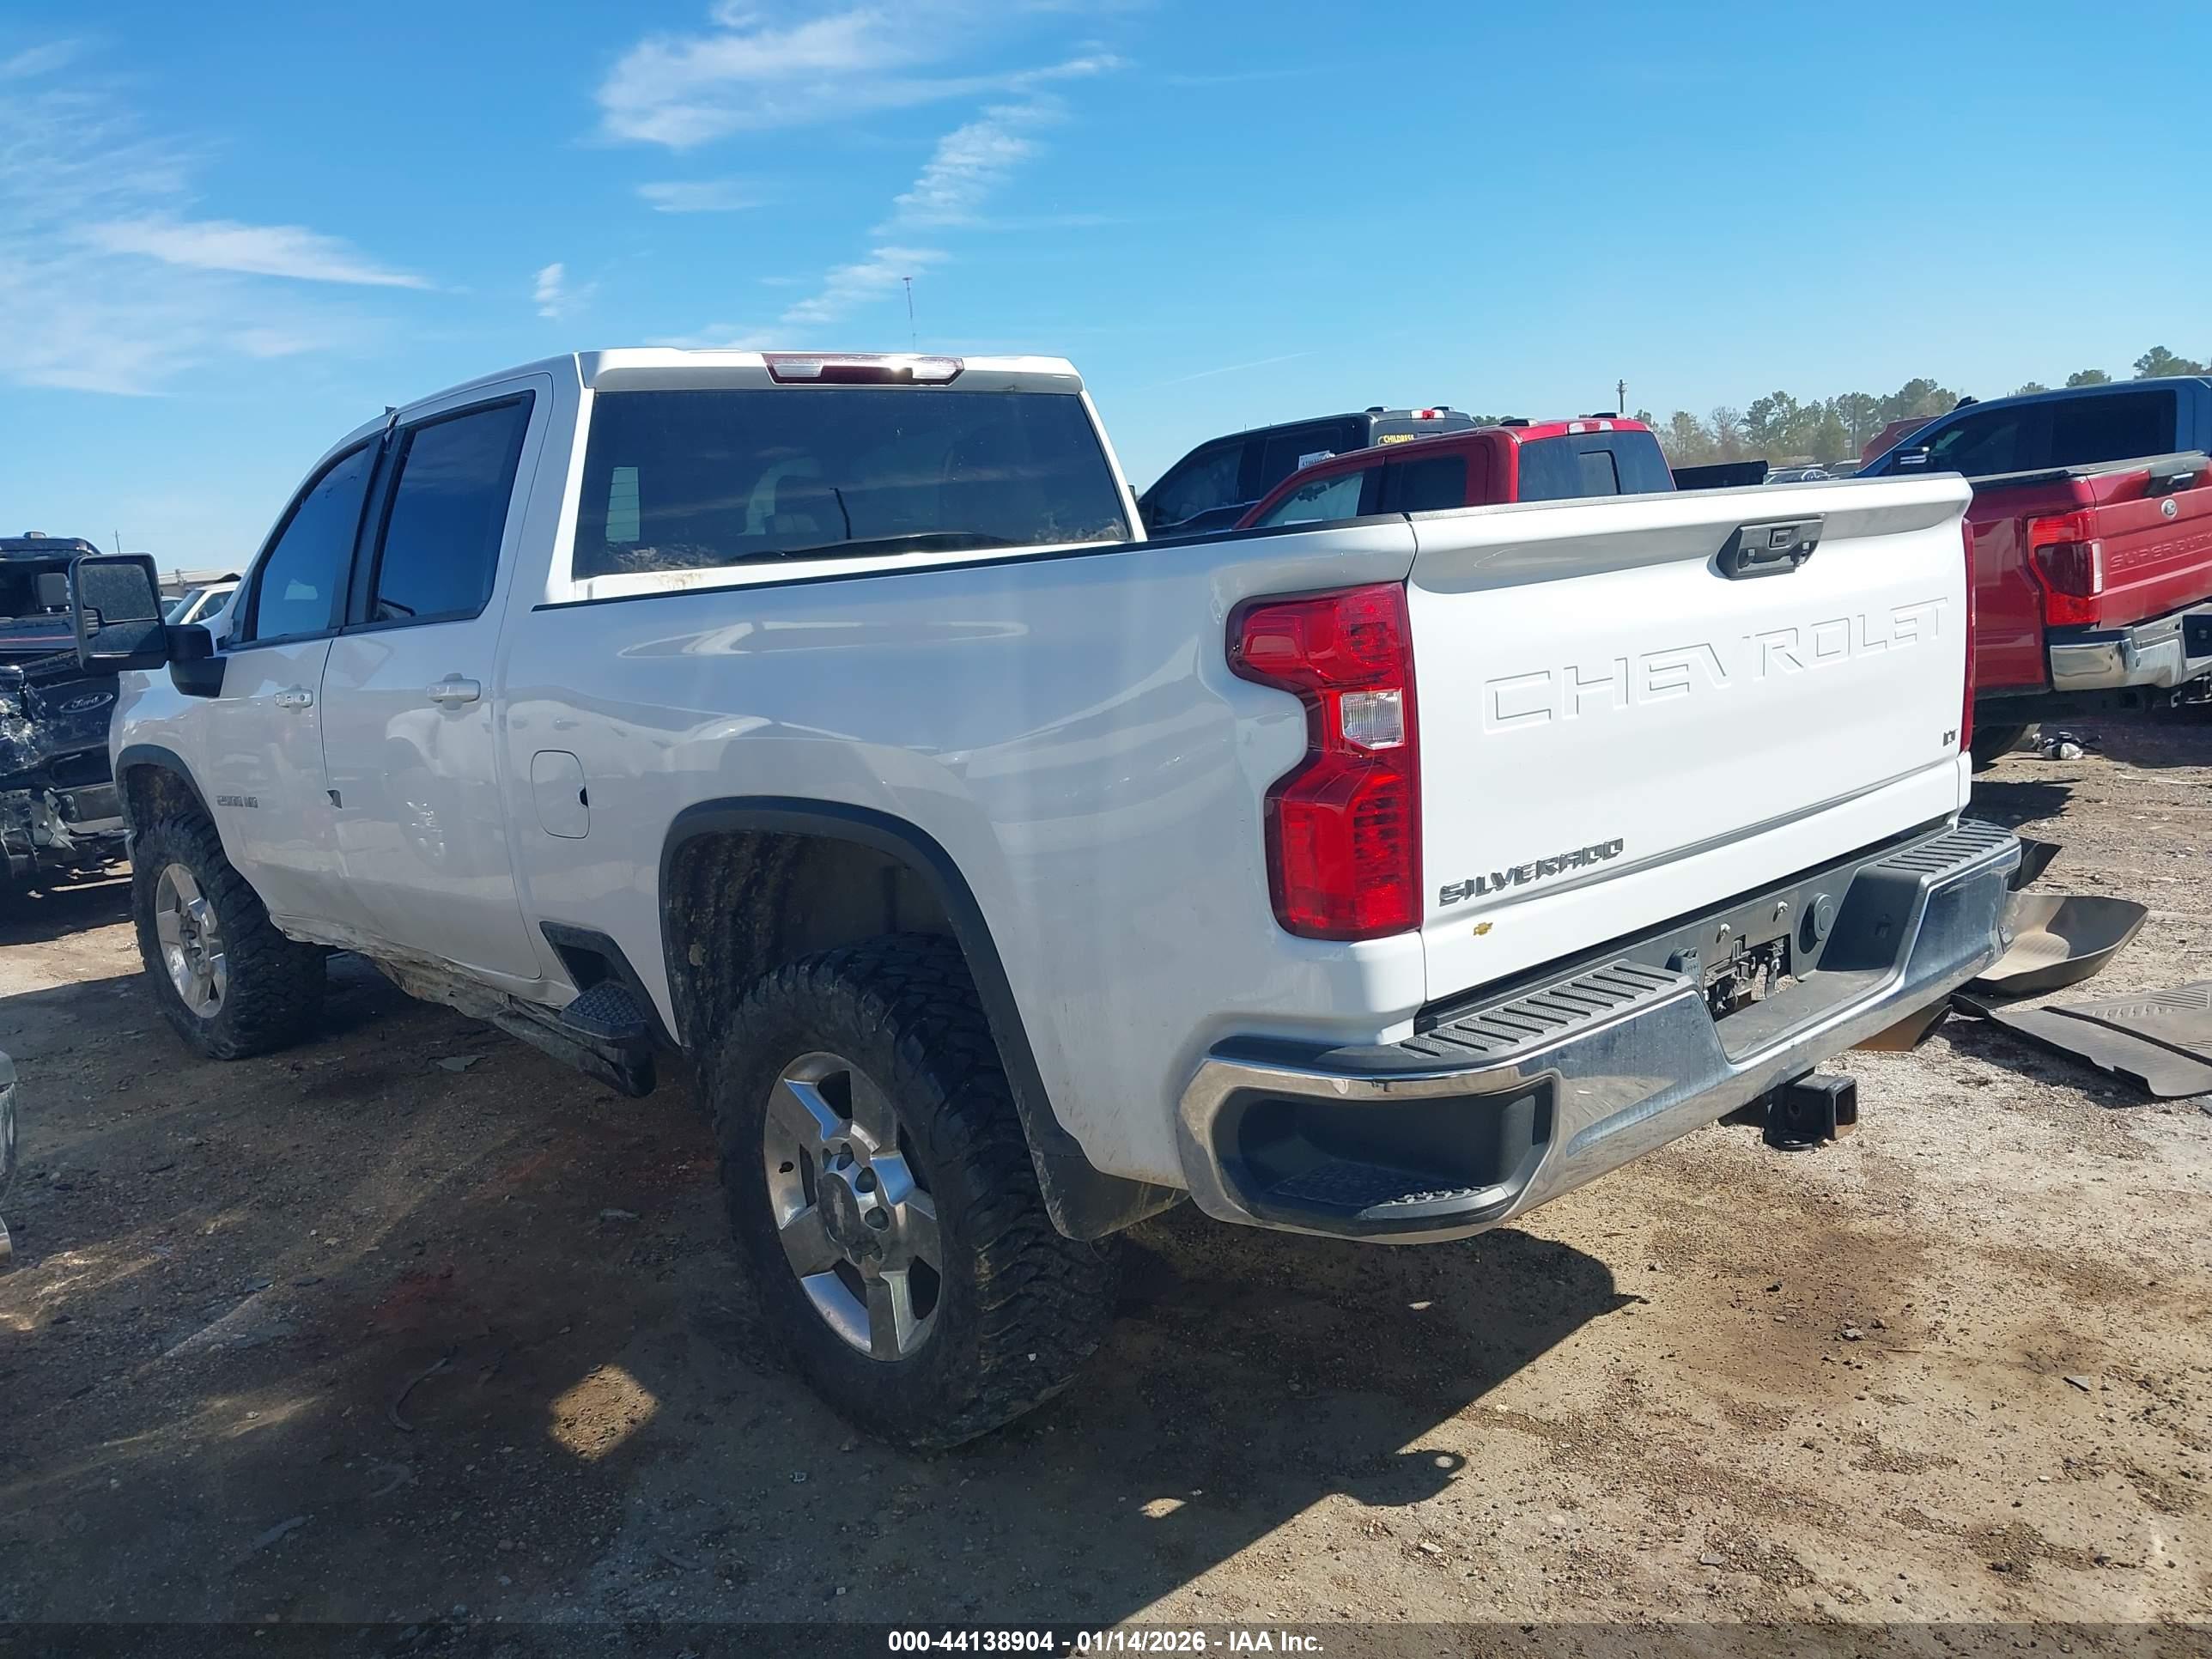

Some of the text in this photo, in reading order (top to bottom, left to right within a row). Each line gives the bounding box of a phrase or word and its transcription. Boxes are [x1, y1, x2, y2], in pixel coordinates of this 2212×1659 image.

[2110, 543, 2173, 568] SUPER
[1483, 597, 1948, 735] CHEVROLET
[1439, 837, 1624, 907] SILVERADO
